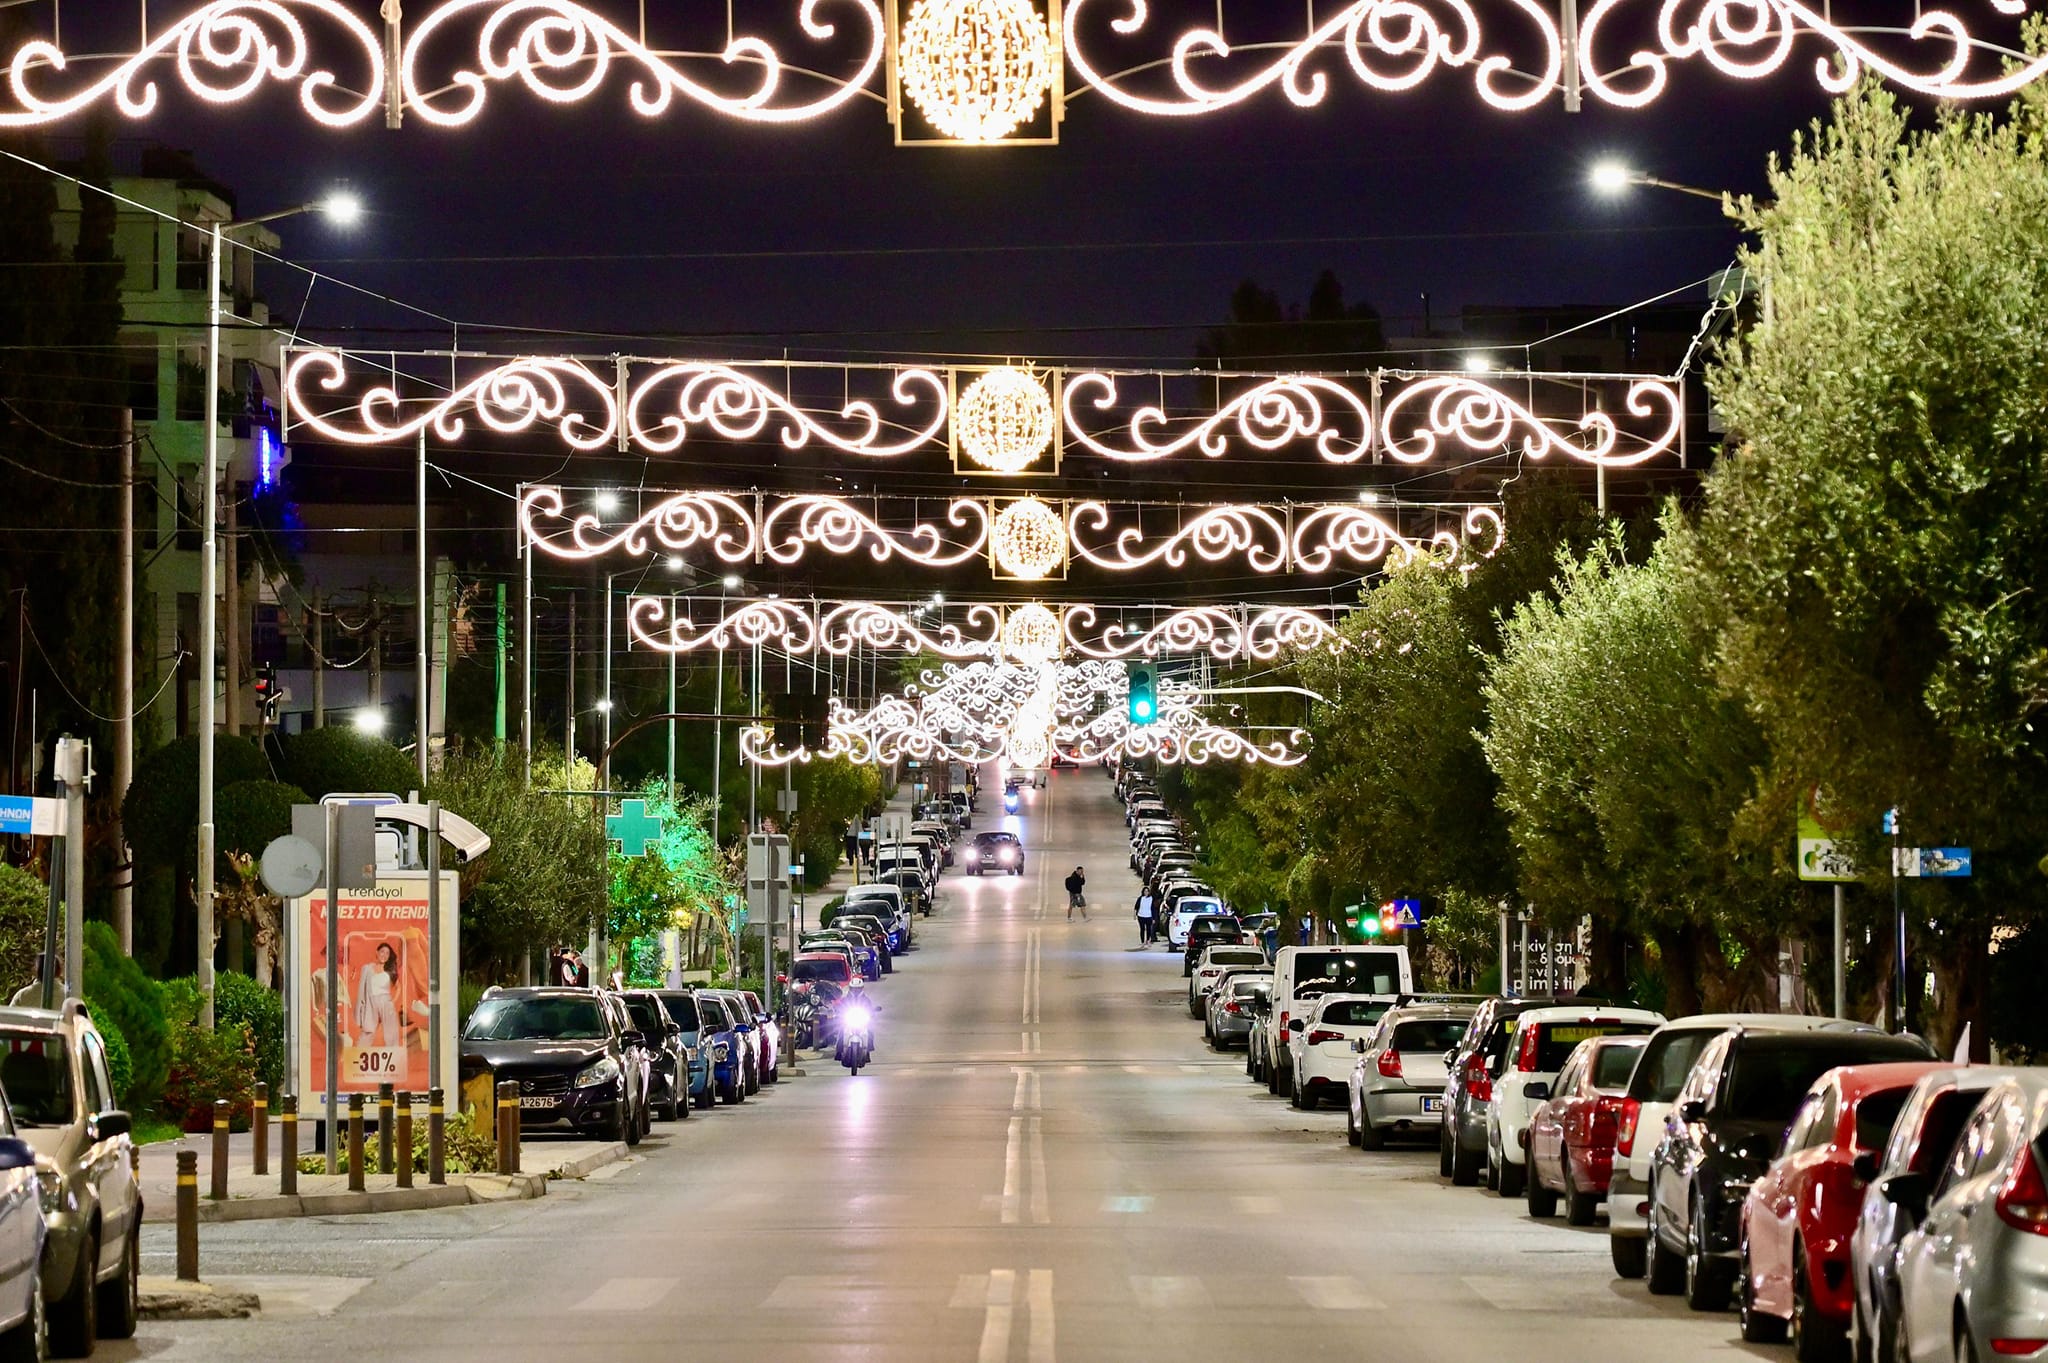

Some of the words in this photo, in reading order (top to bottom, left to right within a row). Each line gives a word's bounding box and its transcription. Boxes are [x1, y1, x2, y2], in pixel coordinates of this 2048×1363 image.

[348, 887, 404, 899] trendyol
[357, 905, 383, 919] ΣΤΟ
[1527, 939, 1572, 955] κίνση
[353, 1052, 396, 1072] -30%
